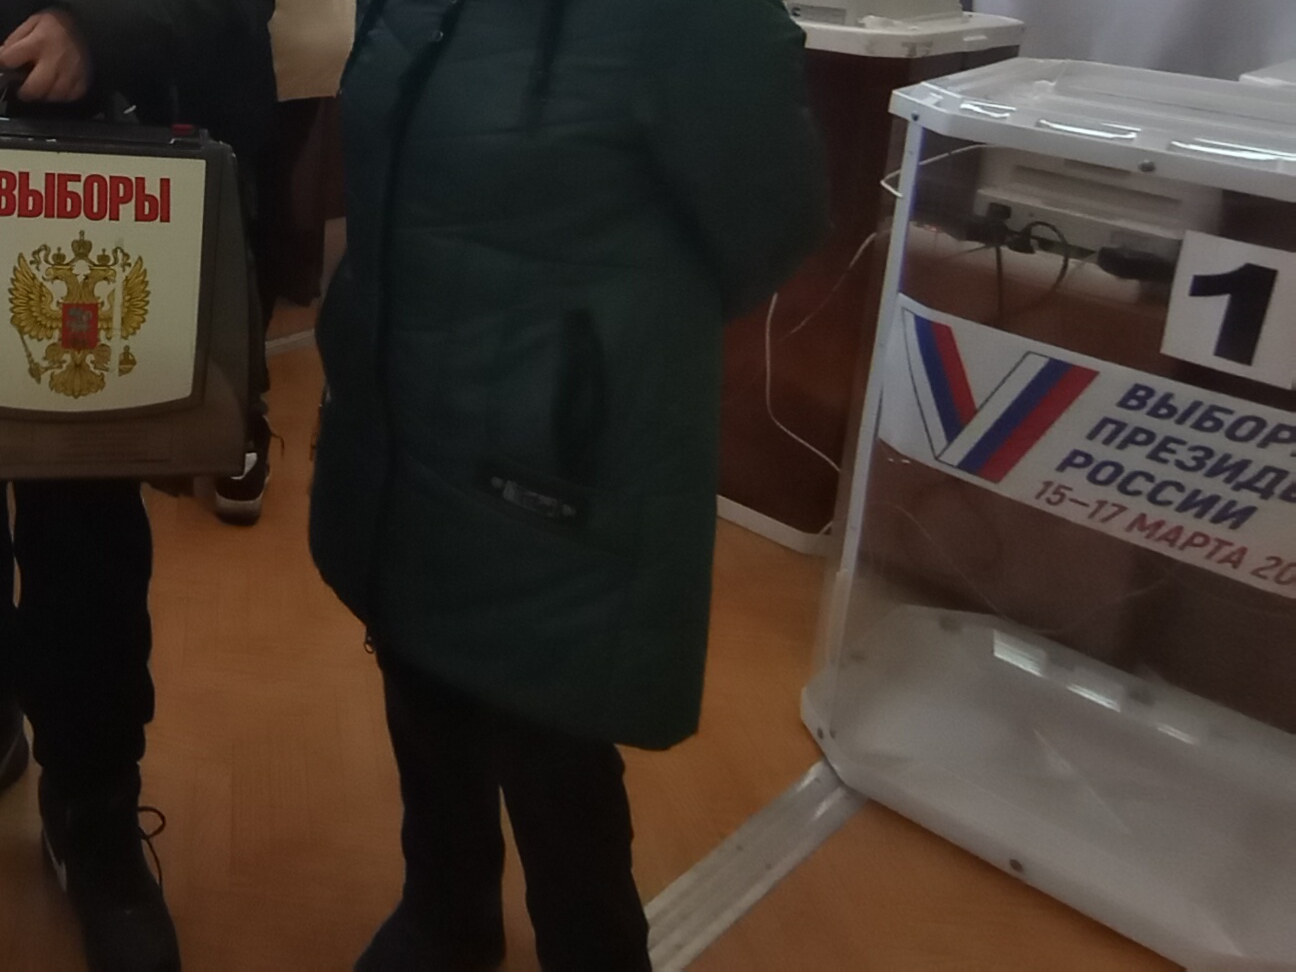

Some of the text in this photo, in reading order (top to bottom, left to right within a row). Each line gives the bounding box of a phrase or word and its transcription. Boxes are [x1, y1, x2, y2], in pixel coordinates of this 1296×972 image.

[1188, 262, 1279, 367] 1
[1116, 383, 1296, 457] ВЫБОР
[1055, 449, 1259, 530] РОССИИ
[1125, 512, 1249, 570] МАРТА
